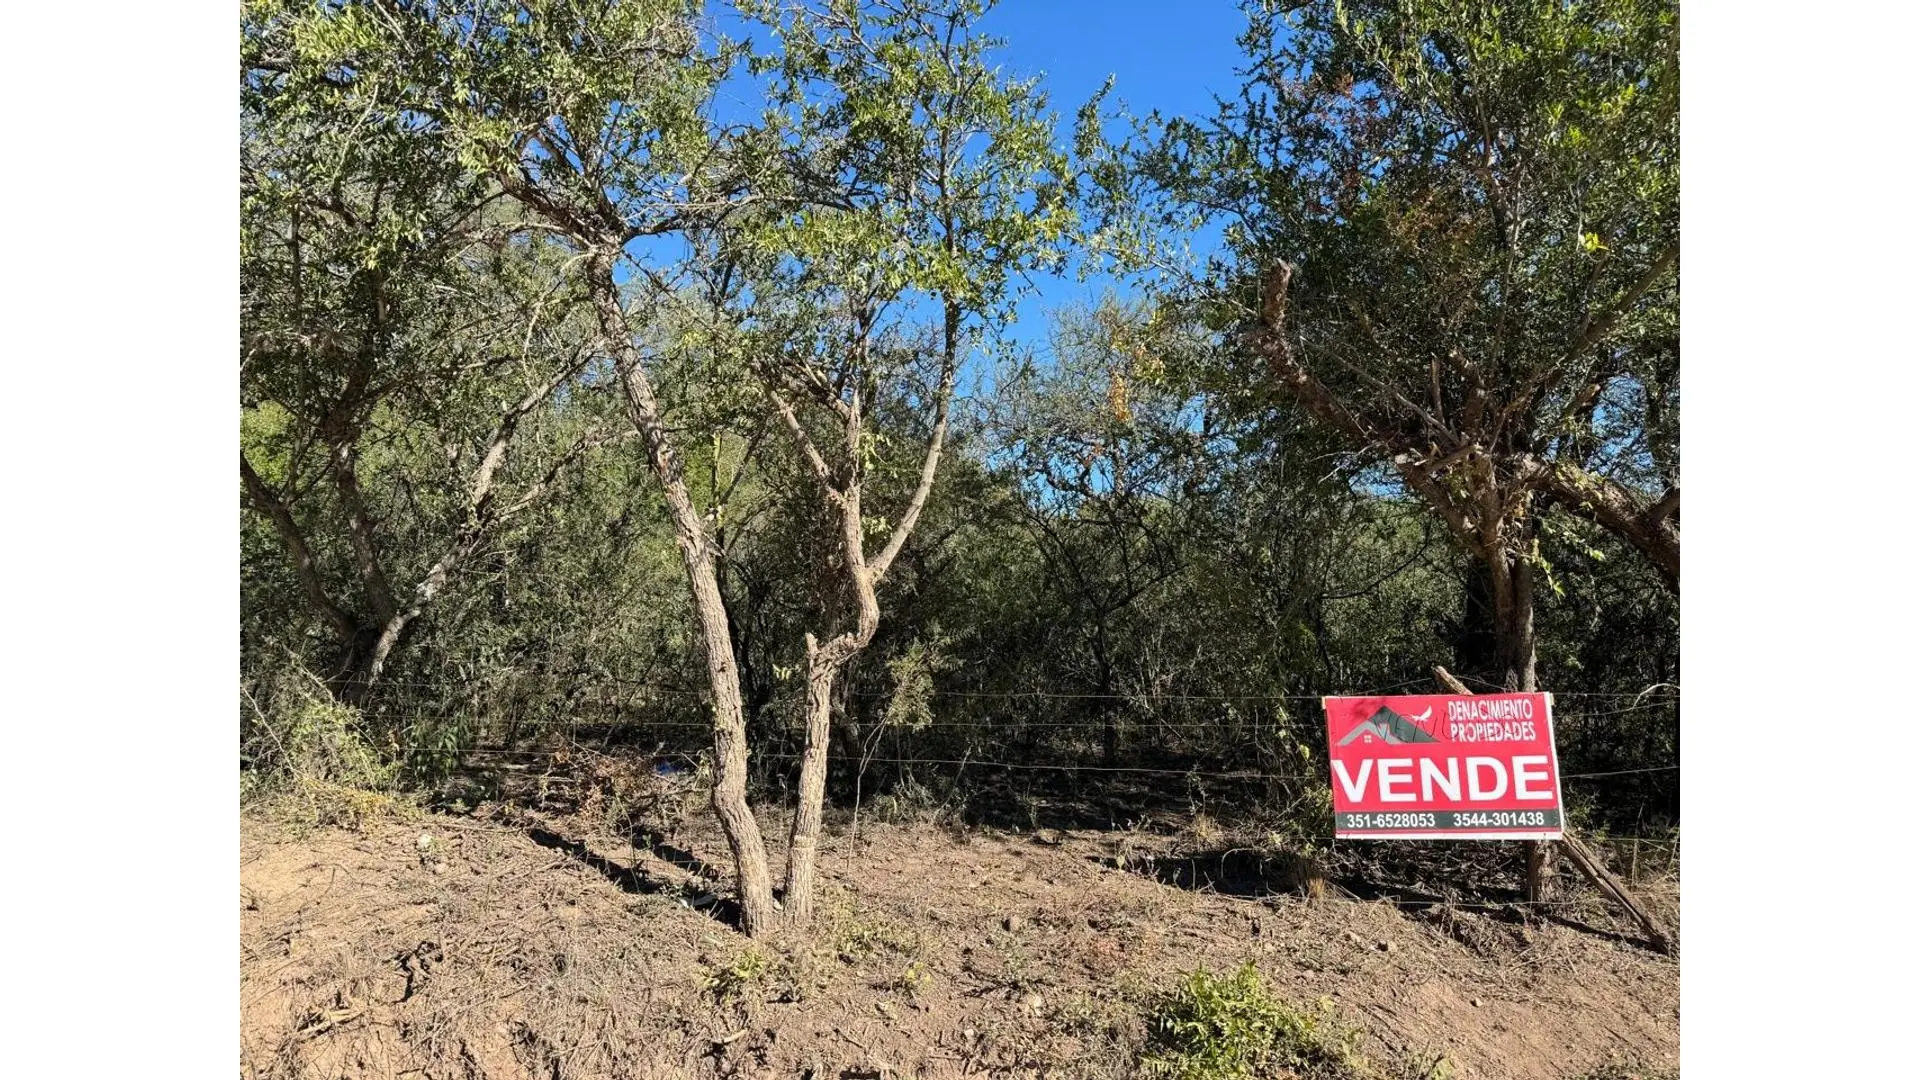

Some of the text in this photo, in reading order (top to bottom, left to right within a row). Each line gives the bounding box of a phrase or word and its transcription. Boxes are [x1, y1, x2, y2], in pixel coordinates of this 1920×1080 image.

[1448, 698, 1533, 720] DENACIMIENTO
[1450, 721, 1536, 743] PROPIEDADES
[1331, 755, 1553, 803] VENDE
[1347, 811, 1545, 828] 351-6528053 3544-301438
